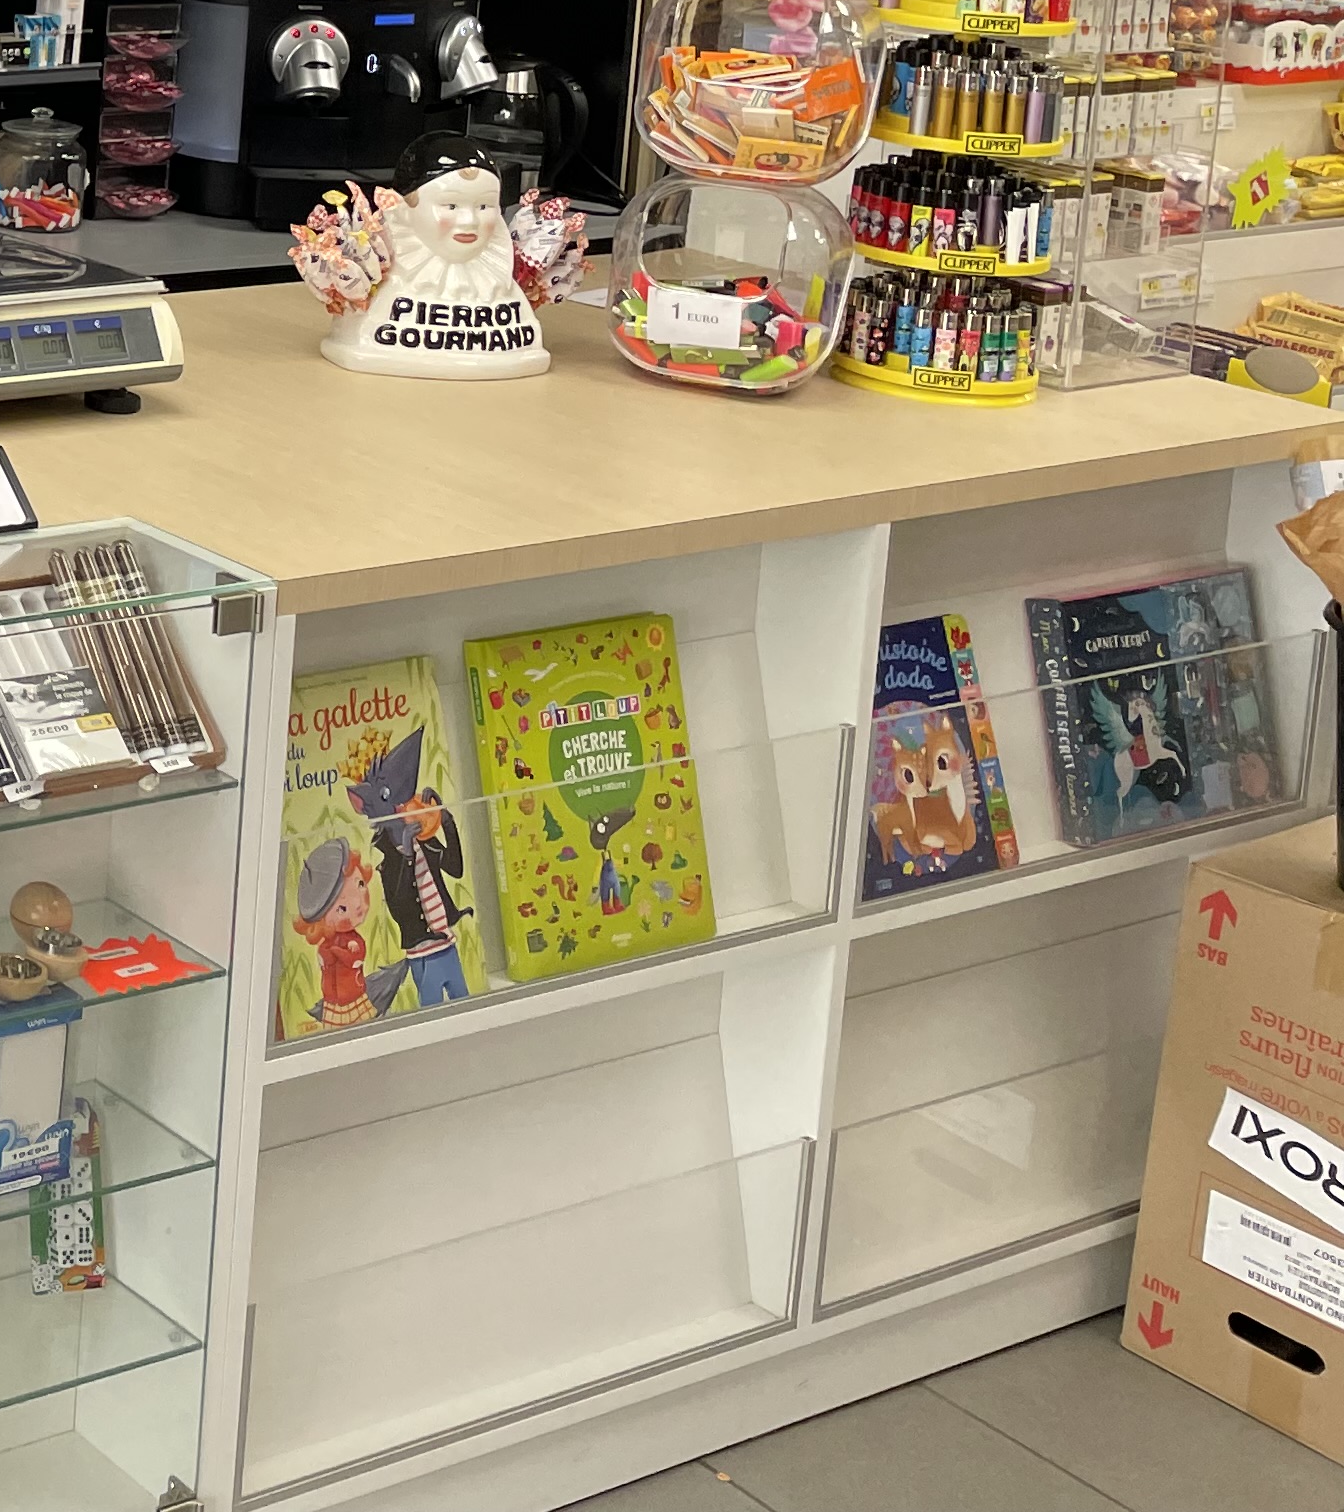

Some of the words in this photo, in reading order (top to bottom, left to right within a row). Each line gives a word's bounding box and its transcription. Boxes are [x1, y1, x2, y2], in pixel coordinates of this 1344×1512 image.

[966, 17, 1018, 34] CLIPPER
[969, 137, 1022, 154] CLIPPER
[943, 257, 995, 274] CLIPPER
[390, 297, 523, 329] PIERROT
[671, 301, 681, 321] 1
[686, 311, 720, 326] EURO
[374, 322, 536, 353] GOURMAND
[918, 372, 971, 390] CLIPPER
[1084, 633, 1121, 655] CARNET
[1120, 628, 1153, 650] SECRET
[883, 667, 936, 692] dodo
[313, 685, 411, 751] galette
[561, 729, 628, 759] CHERCHE
[562, 764, 578, 781] et
[576, 750, 633, 778] TROUVE
[296, 765, 340, 798] loup
[1197, 942, 1228, 967] BAS
[1239, 1028, 1312, 1079] fleurs
[1141, 1272, 1180, 1304] HAUT
[1247, 1268, 1325, 1314] MONTBARTIER
